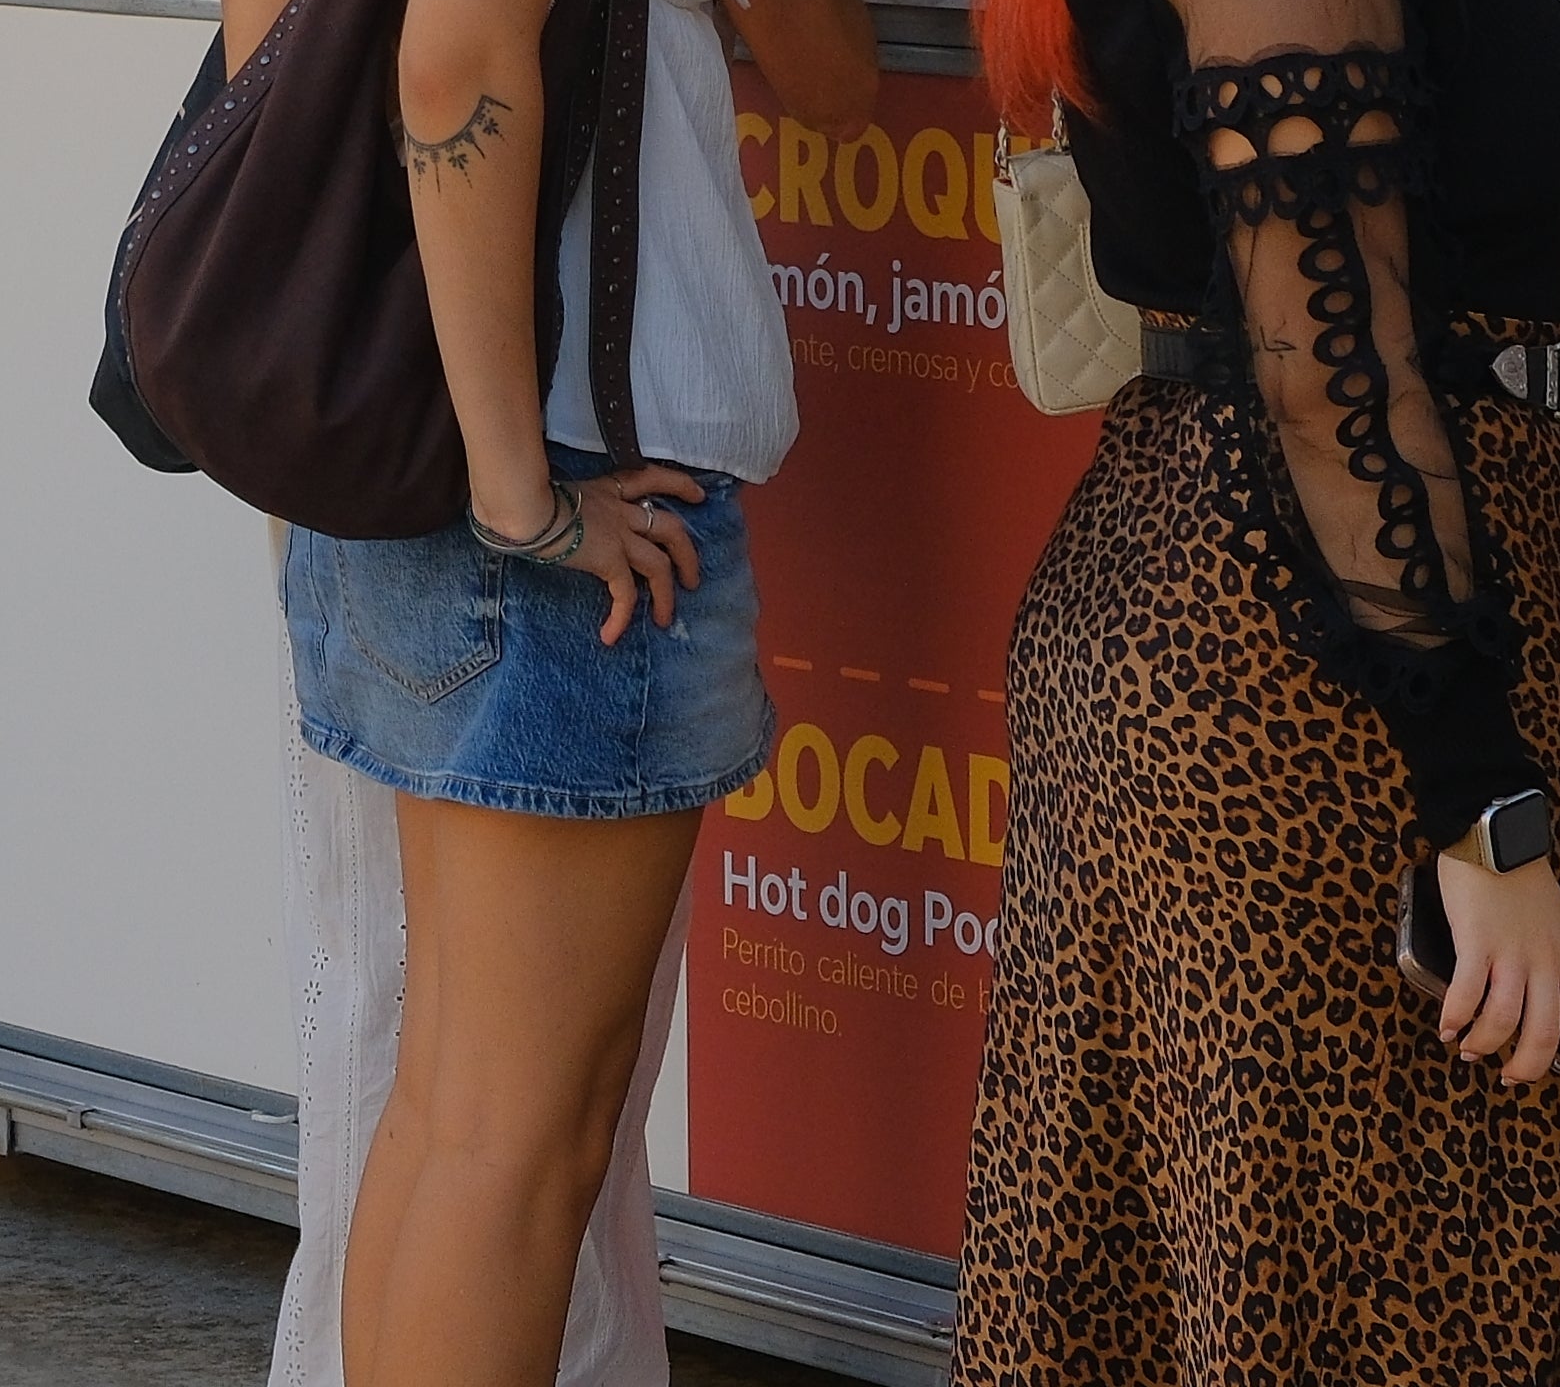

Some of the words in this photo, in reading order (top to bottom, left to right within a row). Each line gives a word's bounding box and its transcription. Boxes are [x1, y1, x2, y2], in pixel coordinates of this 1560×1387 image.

[735, 112, 1055, 245] CROQU
[768, 252, 877, 326] món,
[886, 259, 1007, 334] jamó
[792, 333, 839, 374] nte,
[847, 344, 959, 381] cremosa
[966, 358, 983, 394] y
[723, 850, 808, 921] Hot
[818, 870, 909, 956] dog
[722, 926, 807, 978] Perrito
[817, 949, 919, 1002] caliente
[931, 971, 965, 1010] de
[722, 985, 843, 1039] cebollino.
